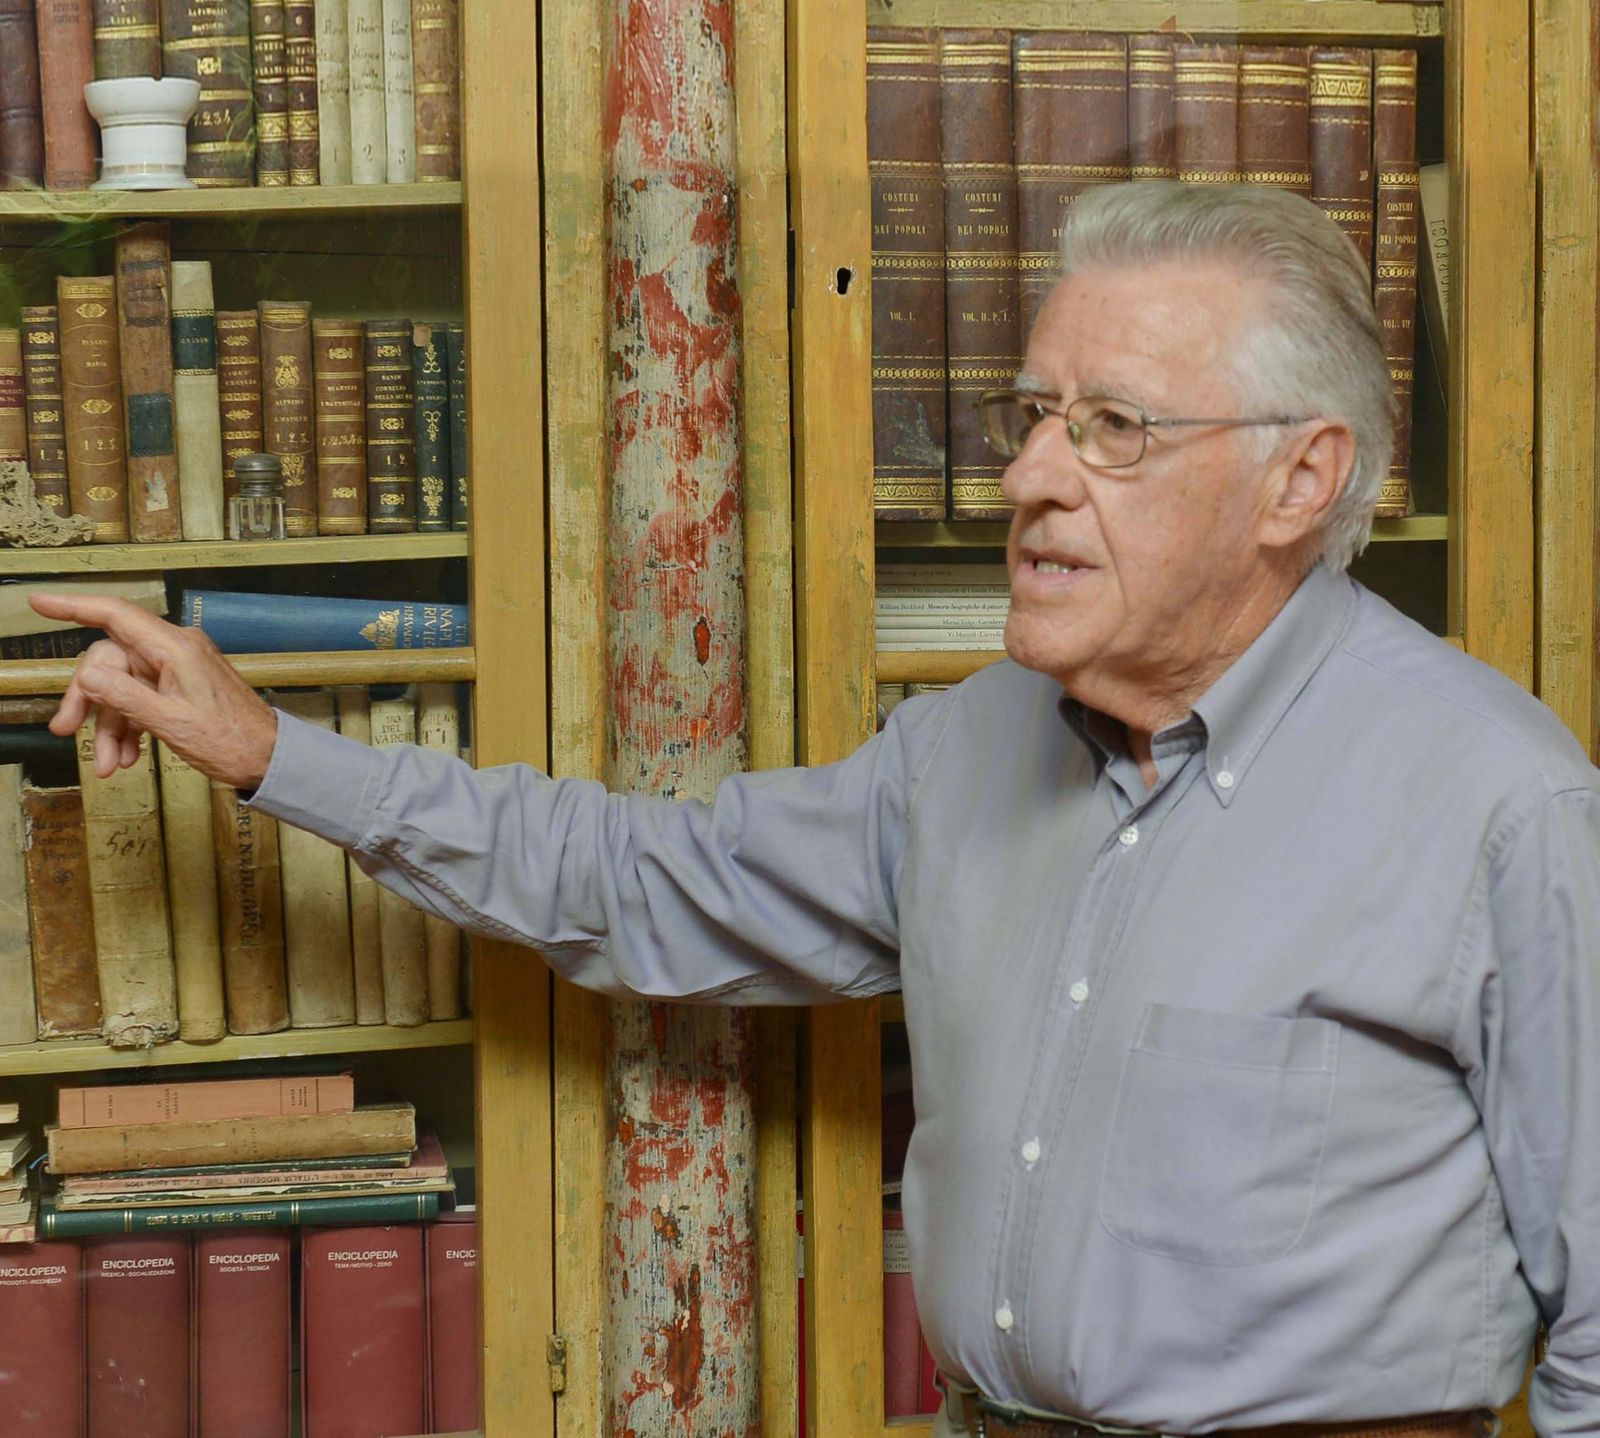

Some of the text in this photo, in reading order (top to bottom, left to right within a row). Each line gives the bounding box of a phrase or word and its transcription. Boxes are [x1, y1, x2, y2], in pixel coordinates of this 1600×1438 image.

[363, 143, 373, 162] 2
[882, 192, 919, 203] COSTUMI
[964, 192, 1002, 203] COSTUMI
[1058, 194, 1080, 204] COST
[1386, 202, 1414, 212] COSTUMI
[874, 224, 926, 235] DEI POPOLI
[957, 224, 1009, 235] DEI POPOLI
[1052, 228, 1063, 238] DE
[1380, 234, 1417, 246] DEI POPOLI
[455, 623, 467, 643] TH
[382, 724, 404, 734] DEL
[209, 1253, 280, 1264] ENCICLOPEDIA
[328, 1250, 398, 1261] ENCICLOPEDIA
[446, 1250, 475, 1259] ENCIC
[102, 1258, 175, 1270] ENCICLOPEDIA
